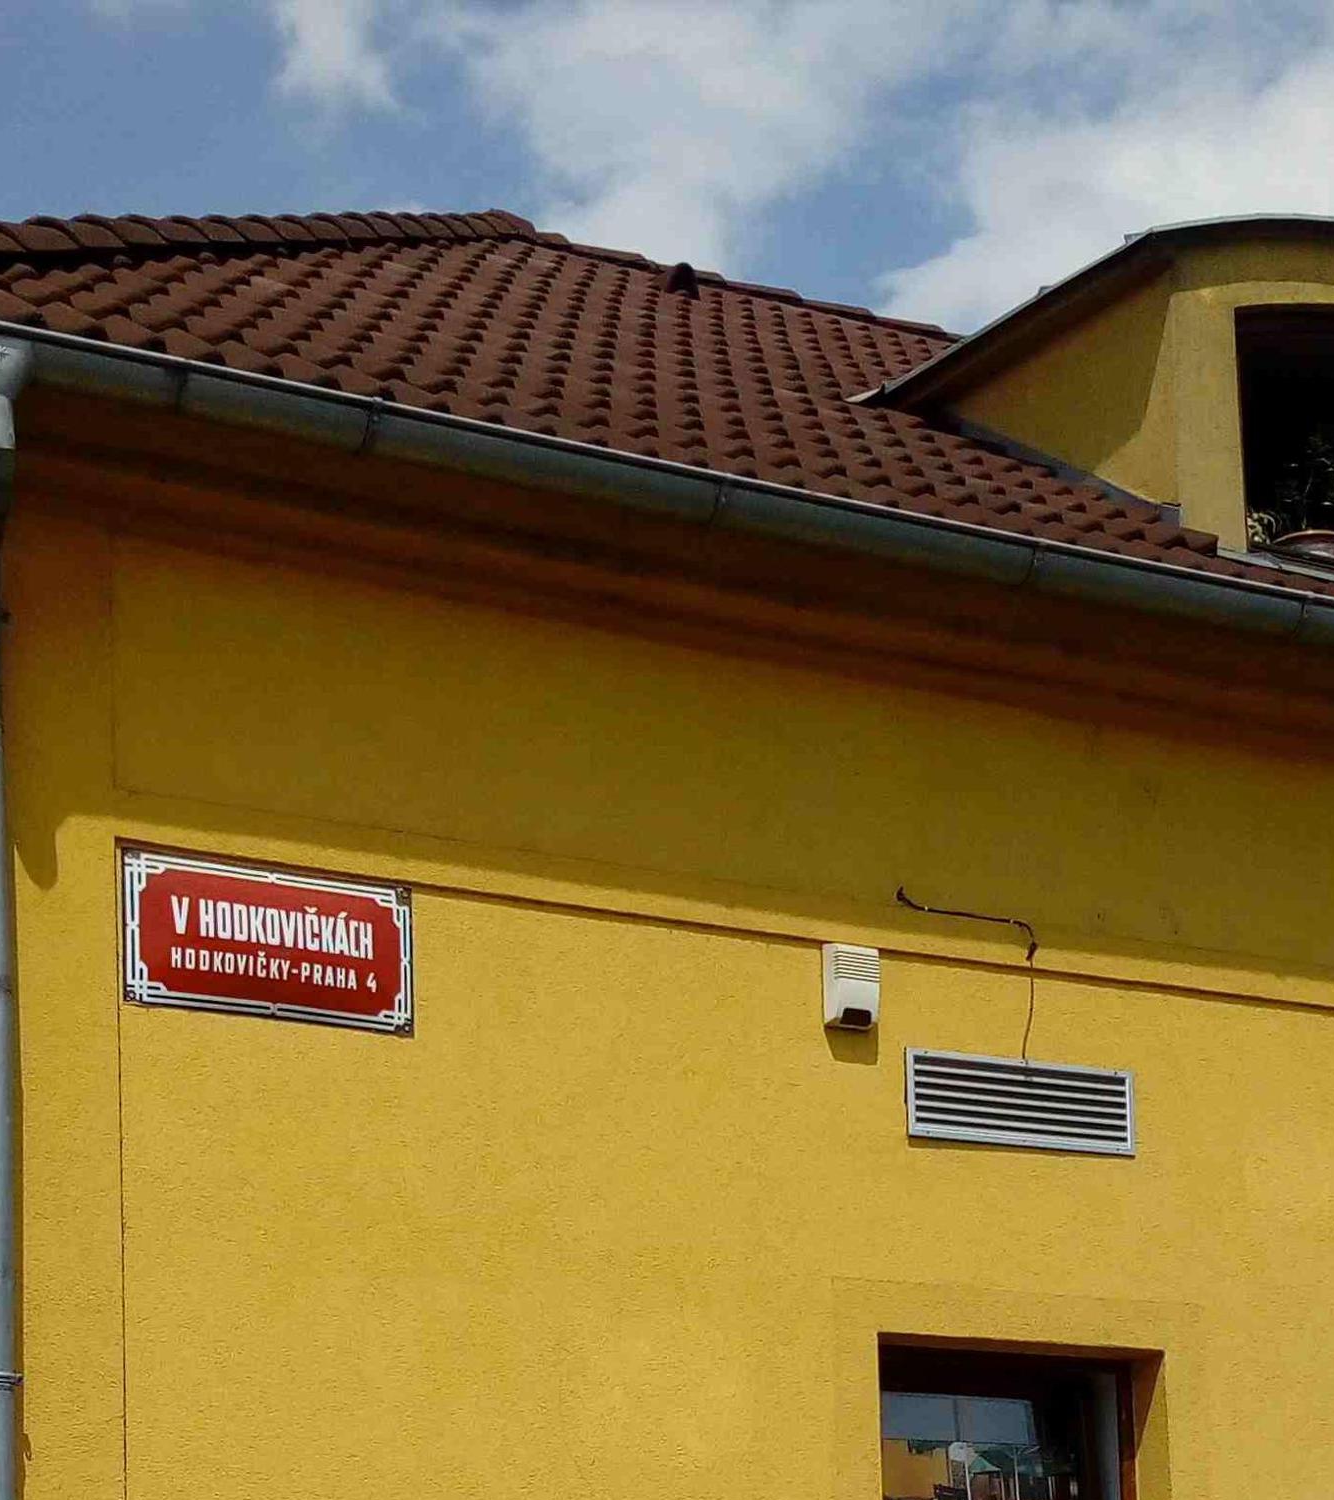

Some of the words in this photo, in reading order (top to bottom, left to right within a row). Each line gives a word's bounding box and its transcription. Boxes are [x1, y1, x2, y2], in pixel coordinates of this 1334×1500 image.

[171, 895, 190, 935] V
[199, 898, 374, 961] HODKOVIČKÁCH
[171, 946, 358, 991] HODKOVIČKY-PRAHA
[366, 971, 377, 993] 4
